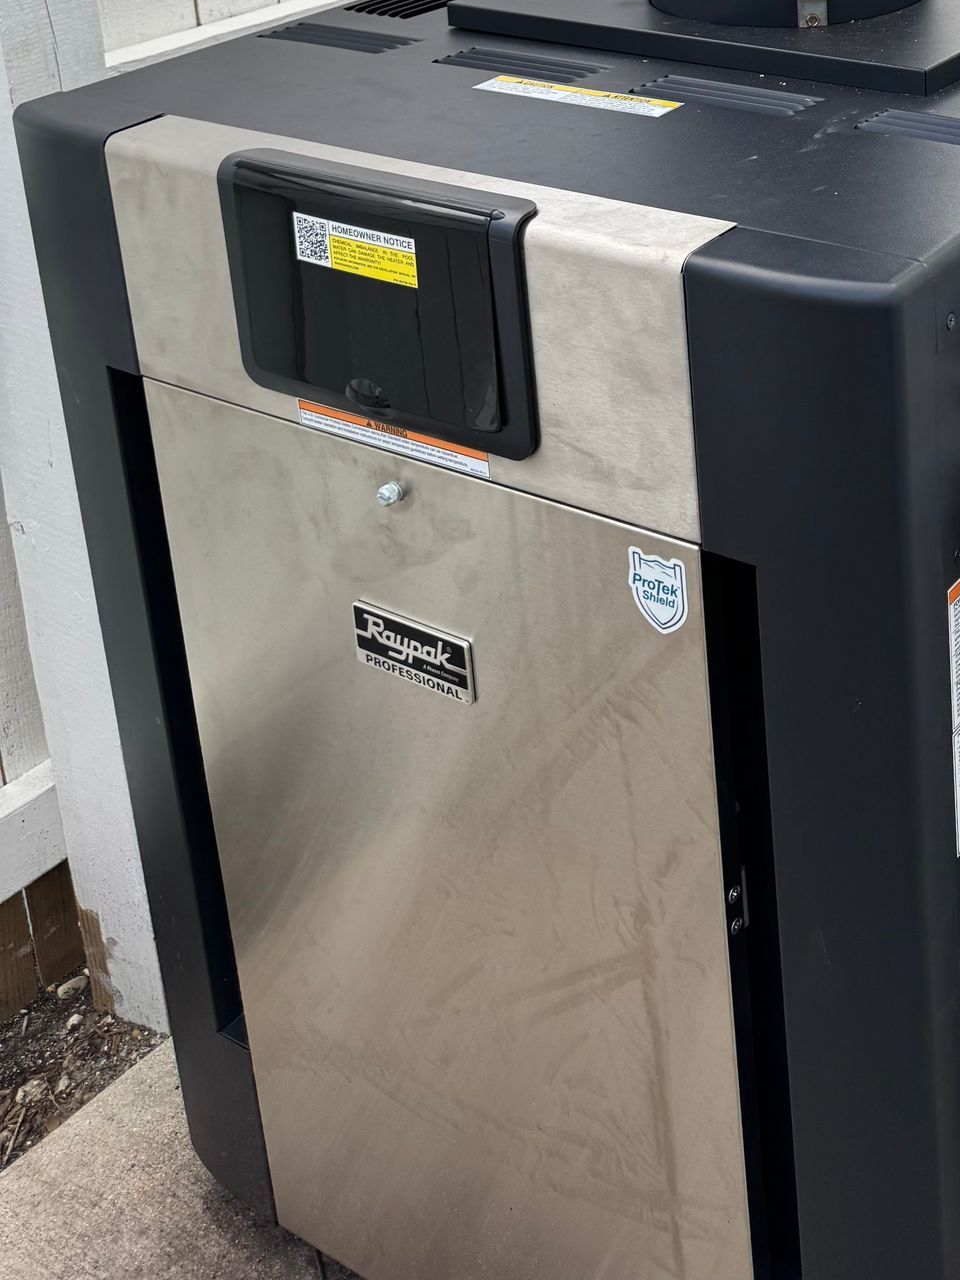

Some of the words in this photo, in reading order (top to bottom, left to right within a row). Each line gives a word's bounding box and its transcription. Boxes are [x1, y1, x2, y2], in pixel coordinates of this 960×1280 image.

[331, 224, 381, 242] HOMEOWNER
[383, 236, 412, 250] NOTICE
[332, 238, 352, 247] CHEMICAL
[355, 244, 378, 253] IMBALANCE
[332, 250, 348, 258] AFFECT
[357, 250, 375, 258] DAMAGE
[386, 256, 402, 264] HEATER
[374, 421, 407, 438] WARNING
[632, 572, 678, 598] ProTek
[642, 590, 675, 608] Shield
[365, 653, 463, 700] PROFESSIONAL
[440, 670, 459, 682] Company
